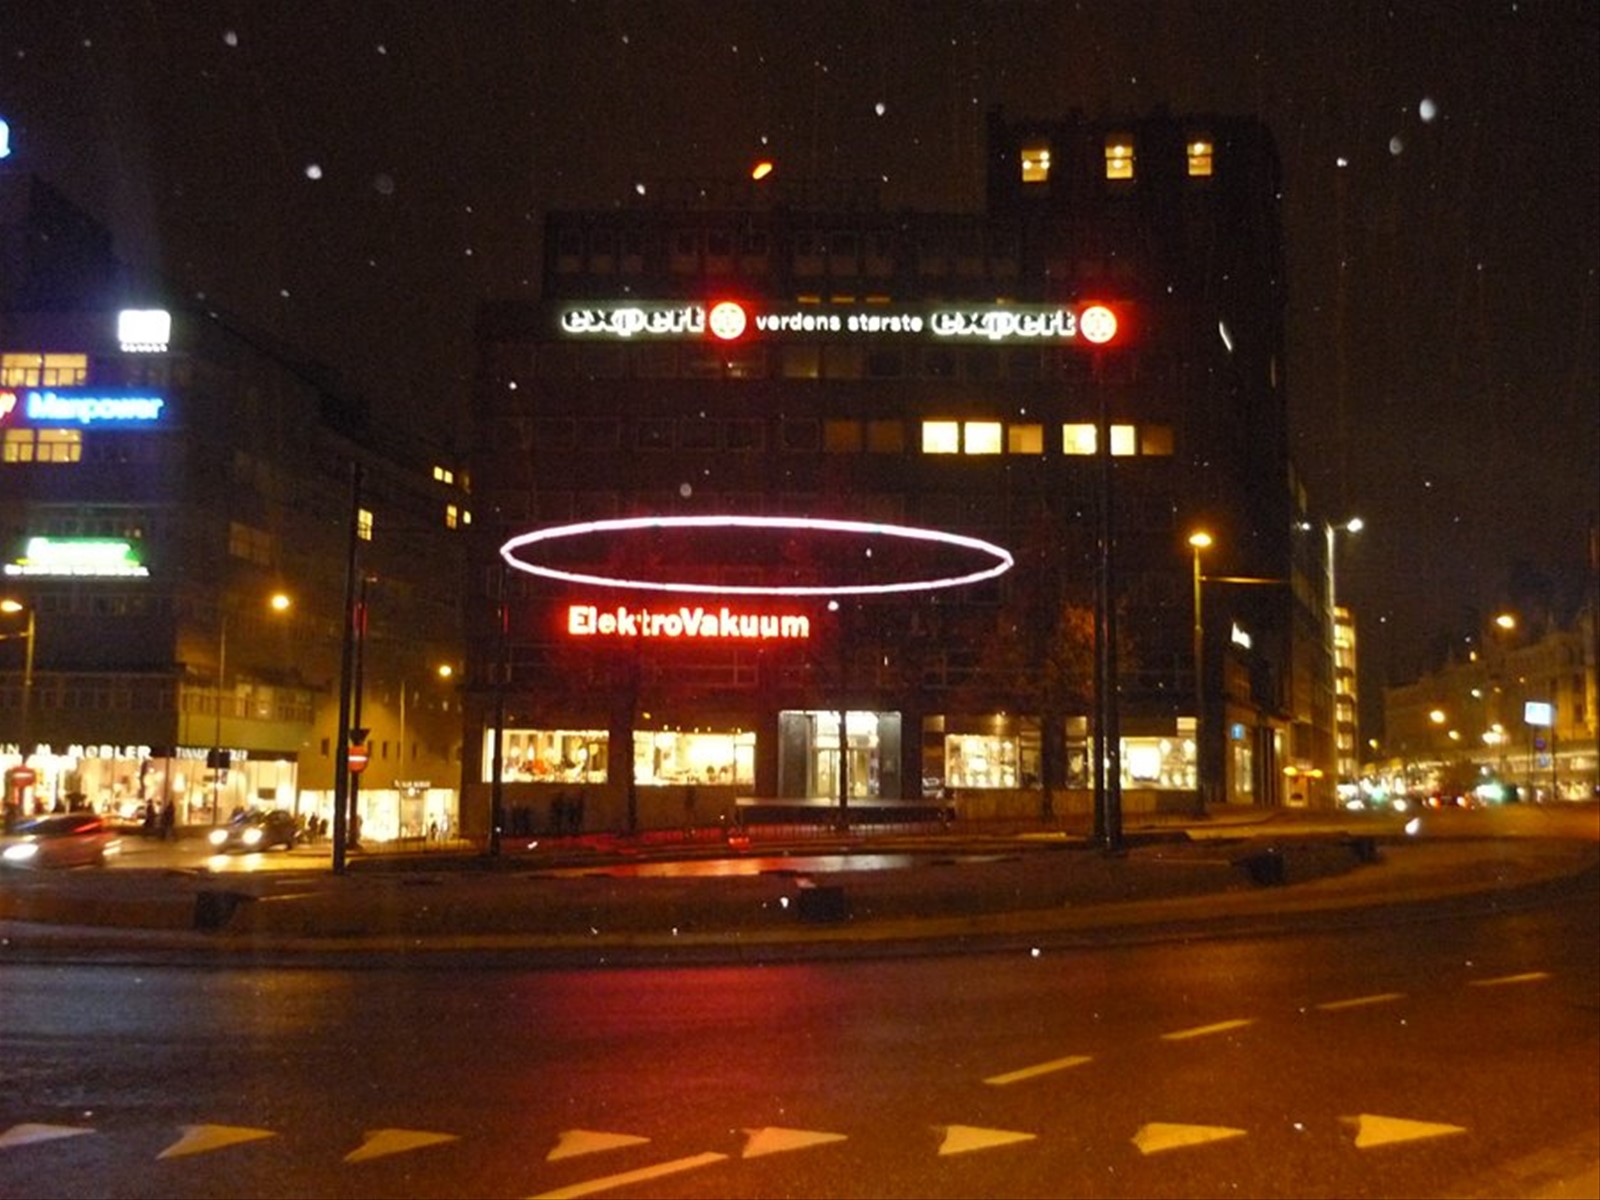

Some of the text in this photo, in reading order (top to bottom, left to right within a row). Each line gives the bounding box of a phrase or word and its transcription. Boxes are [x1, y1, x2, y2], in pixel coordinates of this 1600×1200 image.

[561, 307, 1076, 340] expert verdens største expert
[27, 391, 164, 424] Manpower
[568, 605, 810, 638] ElektroVakuum
